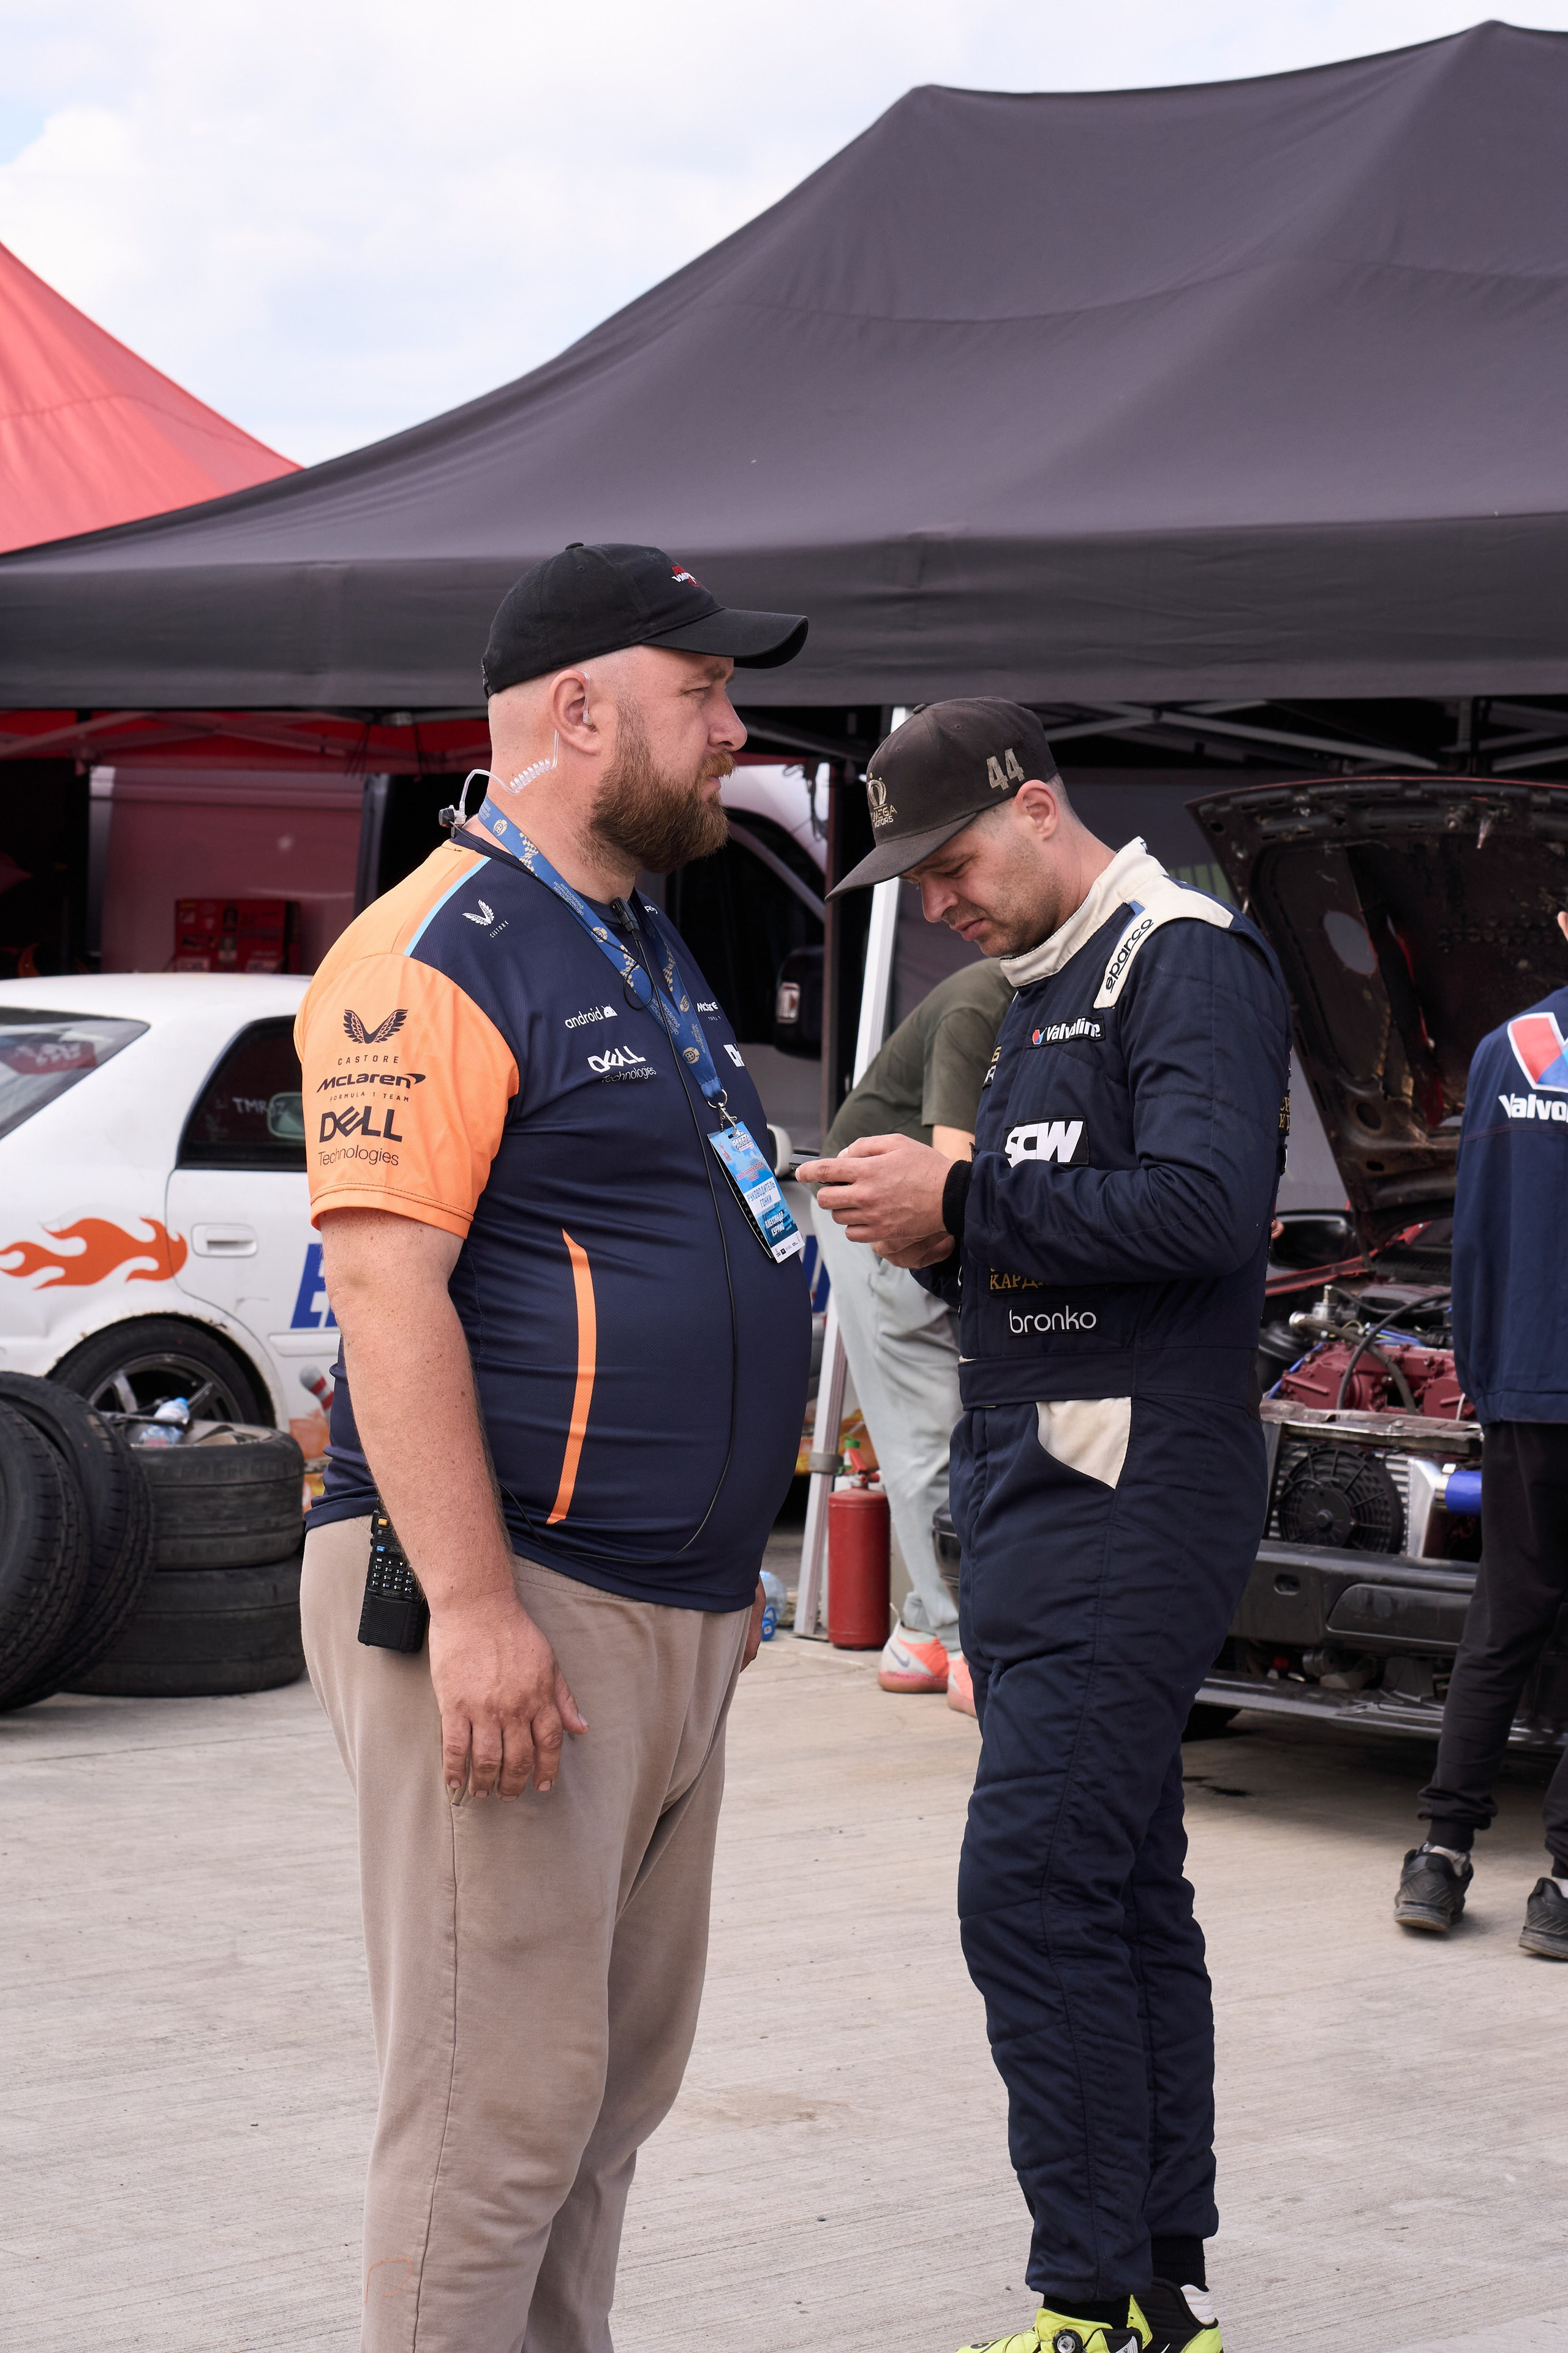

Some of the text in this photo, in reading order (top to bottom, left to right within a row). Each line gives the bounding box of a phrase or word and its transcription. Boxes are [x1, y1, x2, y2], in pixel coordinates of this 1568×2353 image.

[986, 747, 1025, 791] 44
[1106, 919, 1153, 992] sparco
[565, 1007, 604, 1029] android
[338, 1055, 399, 1065] CASTORE
[587, 1046, 647, 1073] DELL
[316, 1073, 412, 1093] McLaren
[601, 1065, 657, 1083] Technologies
[330, 1092, 365, 1101] FORMULA
[383, 1093, 409, 1101] TEAM
[1498, 1093, 1568, 1123] Valvo
[319, 1106, 402, 1143] DELL
[318, 1145, 399, 1166] Technologies
[747, 1180, 775, 1203] РУКОВОДИТЕЛЬ
[760, 1194, 773, 1208] ГОНКИ
[1009, 1305, 1096, 1334] bronko
